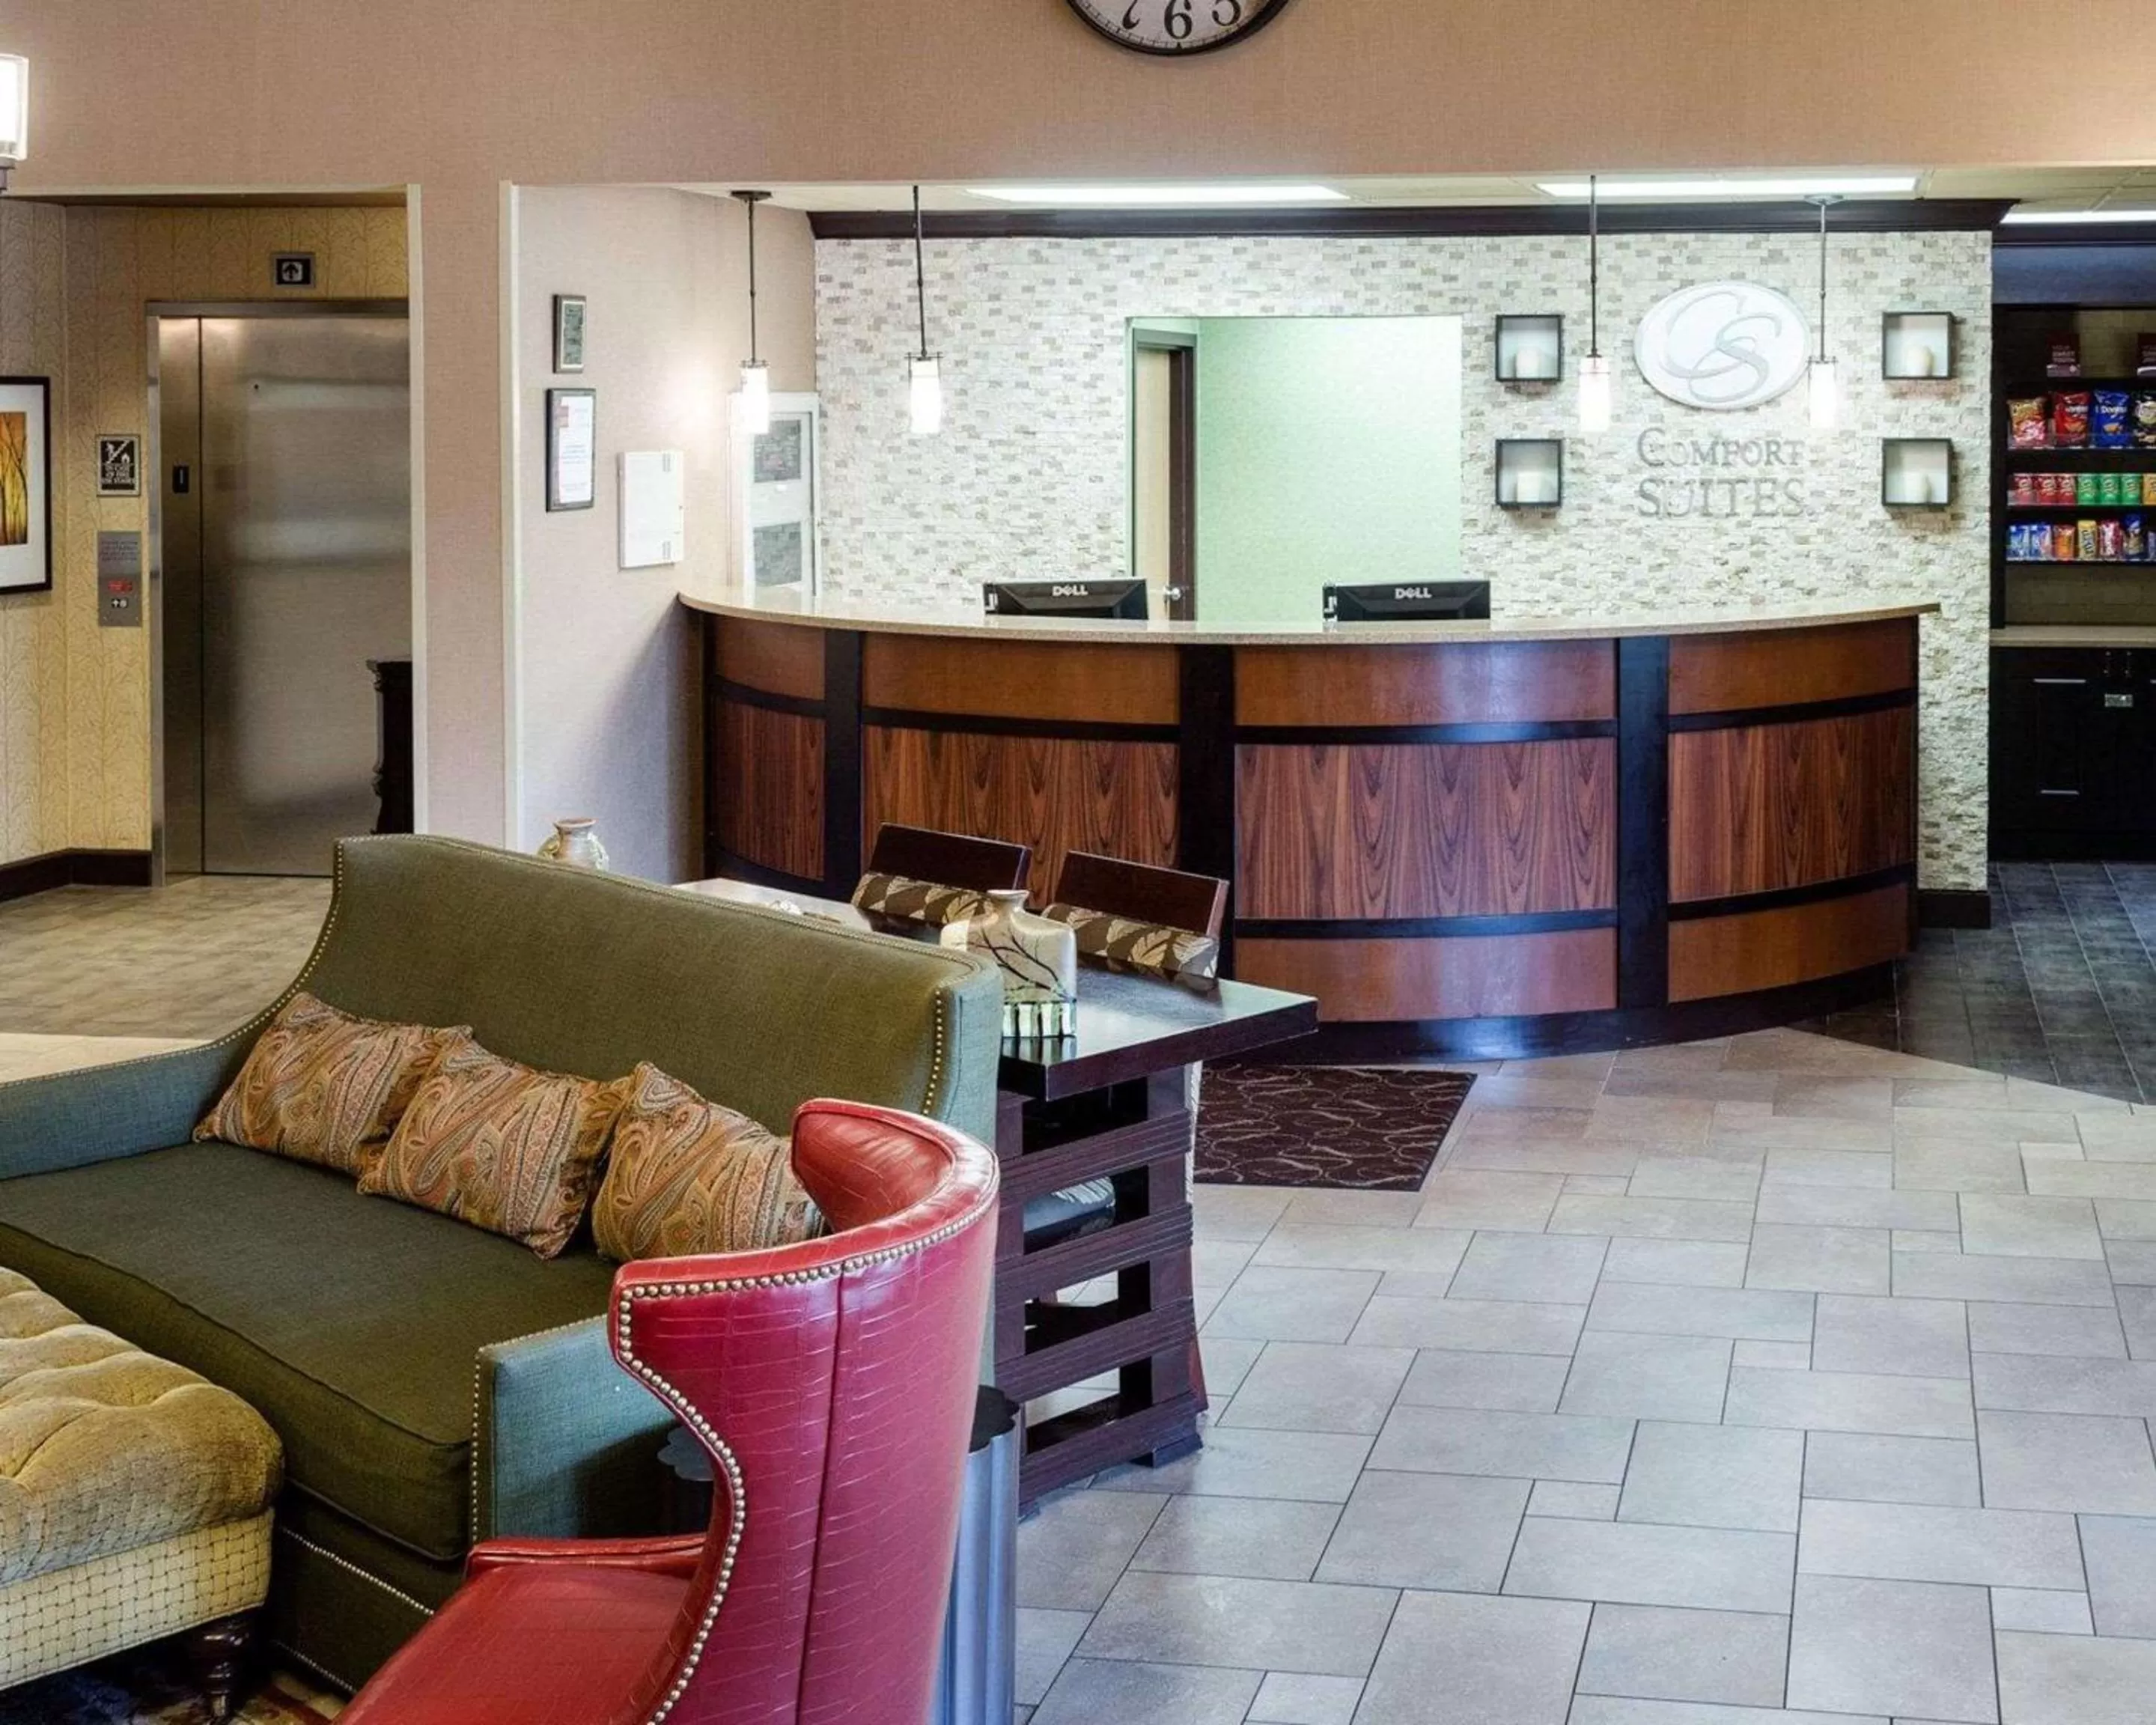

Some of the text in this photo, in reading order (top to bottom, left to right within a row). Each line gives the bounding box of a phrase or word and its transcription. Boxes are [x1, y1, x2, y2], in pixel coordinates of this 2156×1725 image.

[1163, 0, 1193, 39] 6
[1637, 428, 1806, 467] COMFORT
[1637, 476, 1805, 517] SUITES
[1052, 584, 1088, 597] DELL
[1395, 587, 1432, 599] DELL
